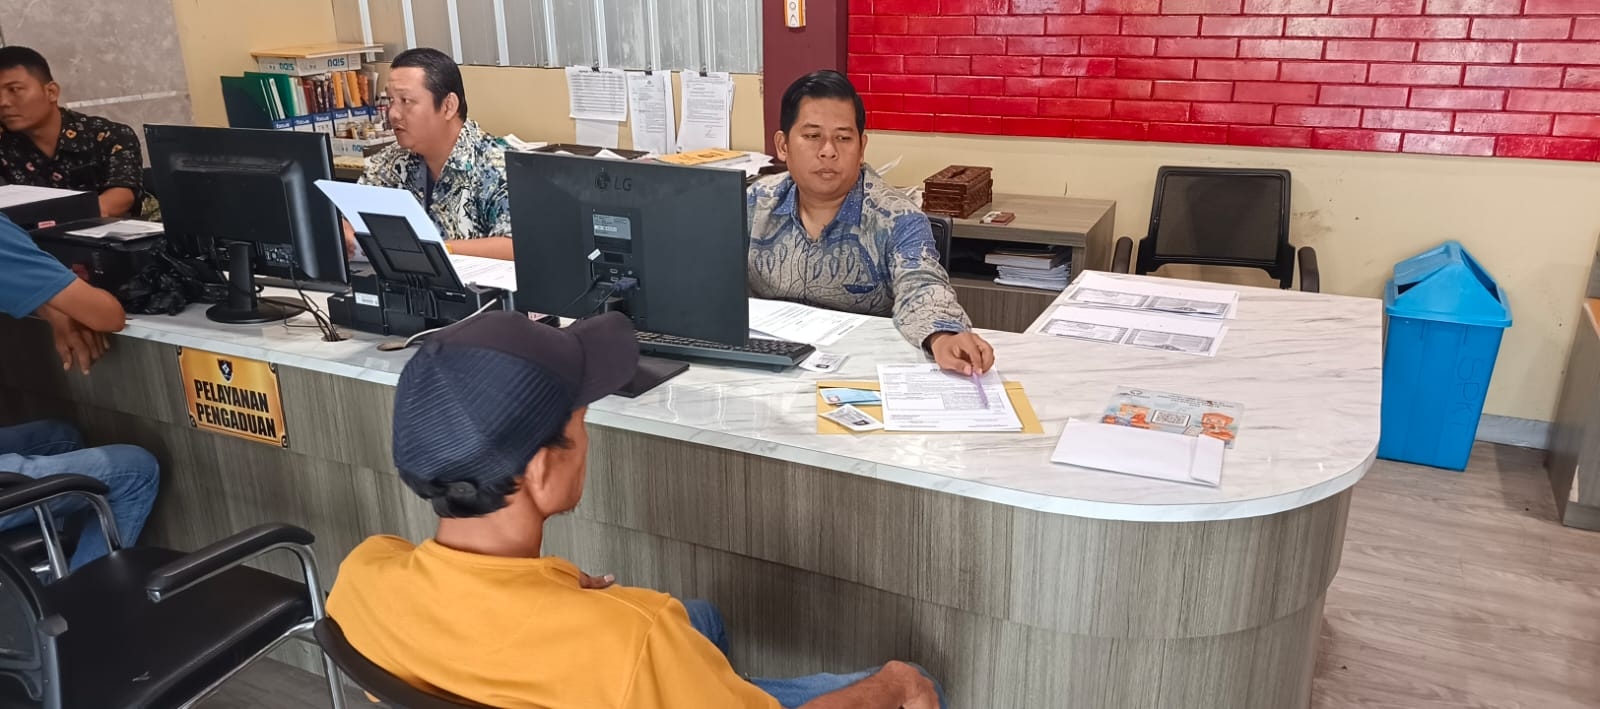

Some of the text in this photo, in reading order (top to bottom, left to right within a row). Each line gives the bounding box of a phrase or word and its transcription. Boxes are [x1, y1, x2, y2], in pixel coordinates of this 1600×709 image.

[614, 176, 632, 191] LG
[194, 379, 269, 413] PELAYANAN
[195, 402, 277, 438] PENGADUAN
